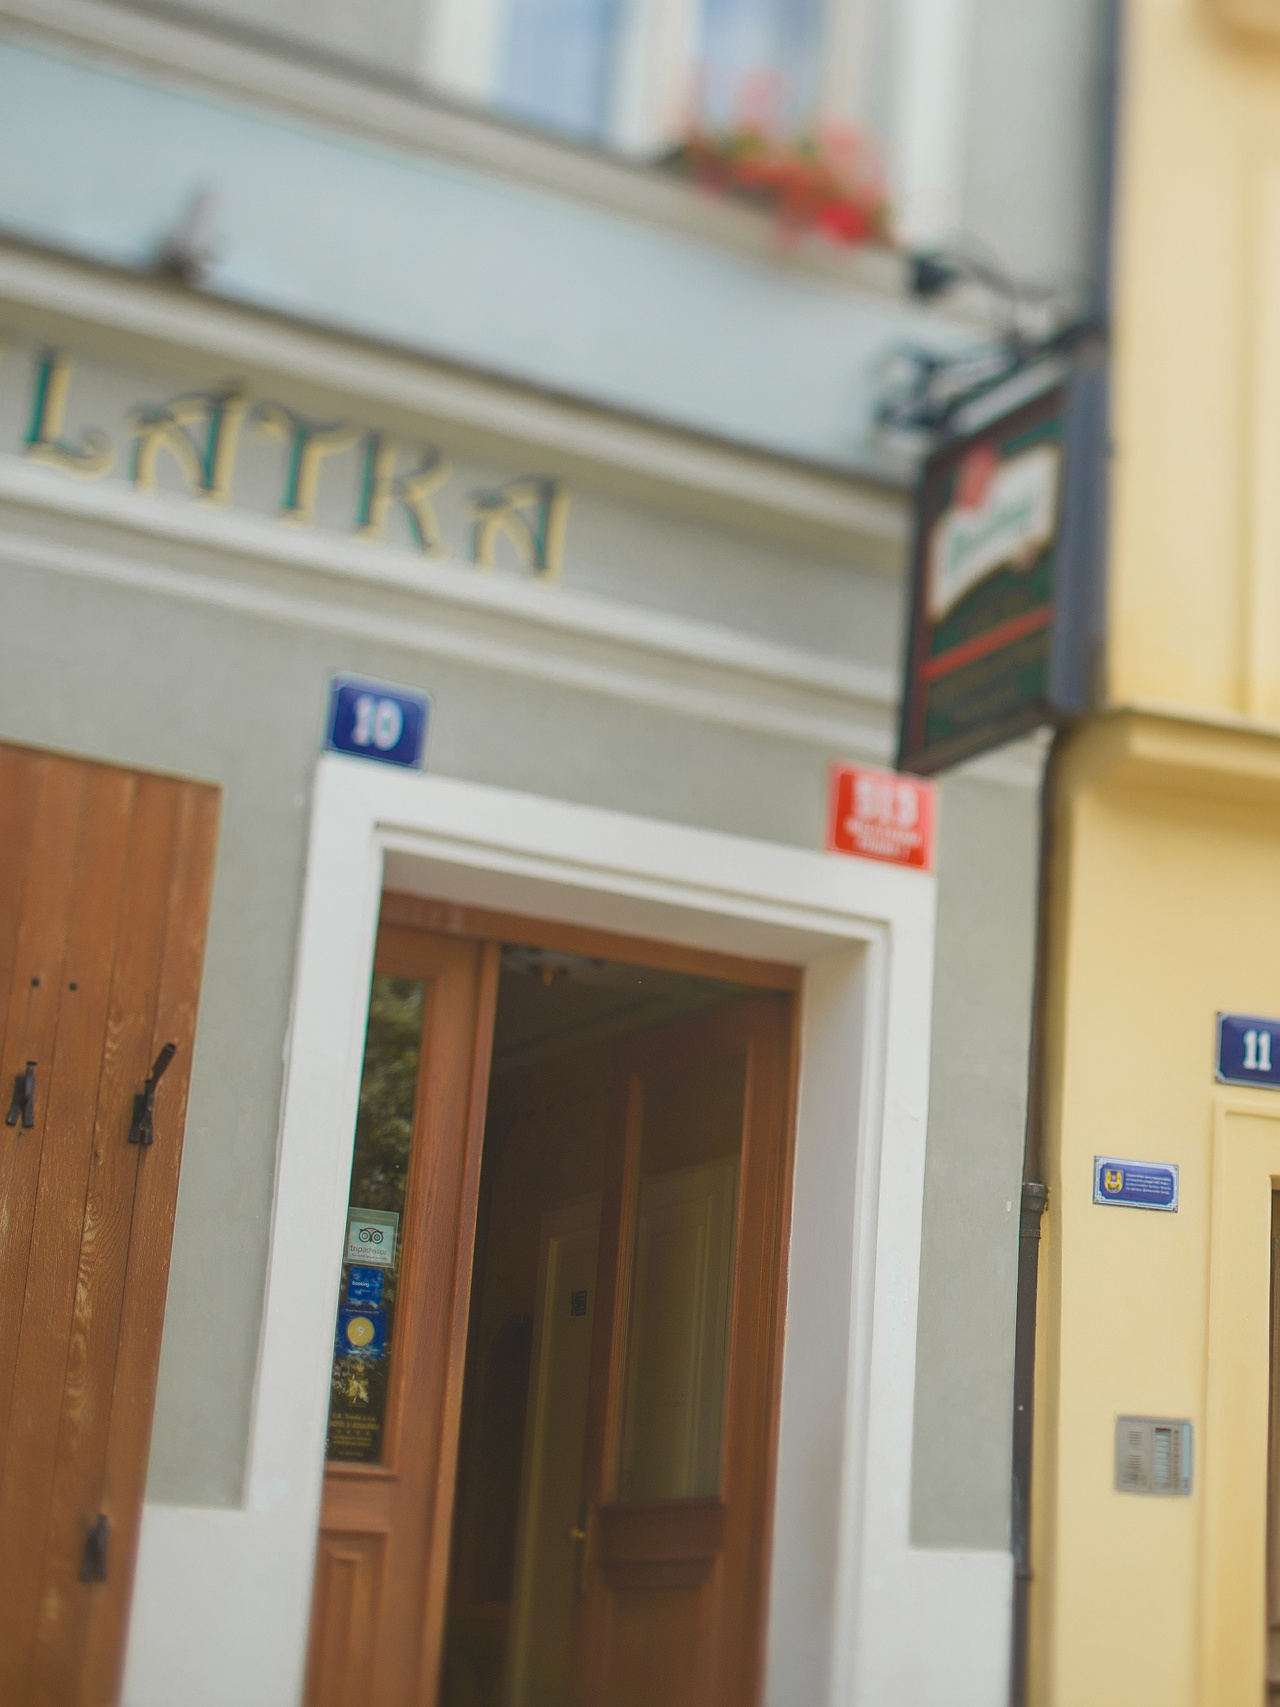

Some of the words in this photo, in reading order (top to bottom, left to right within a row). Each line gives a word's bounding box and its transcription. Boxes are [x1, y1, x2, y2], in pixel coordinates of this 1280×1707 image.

[350, 692, 405, 752] 10
[1242, 1027, 1272, 1072] 11
[350, 1245, 387, 1255] tripadvisor
[357, 1325, 366, 1337] 9
